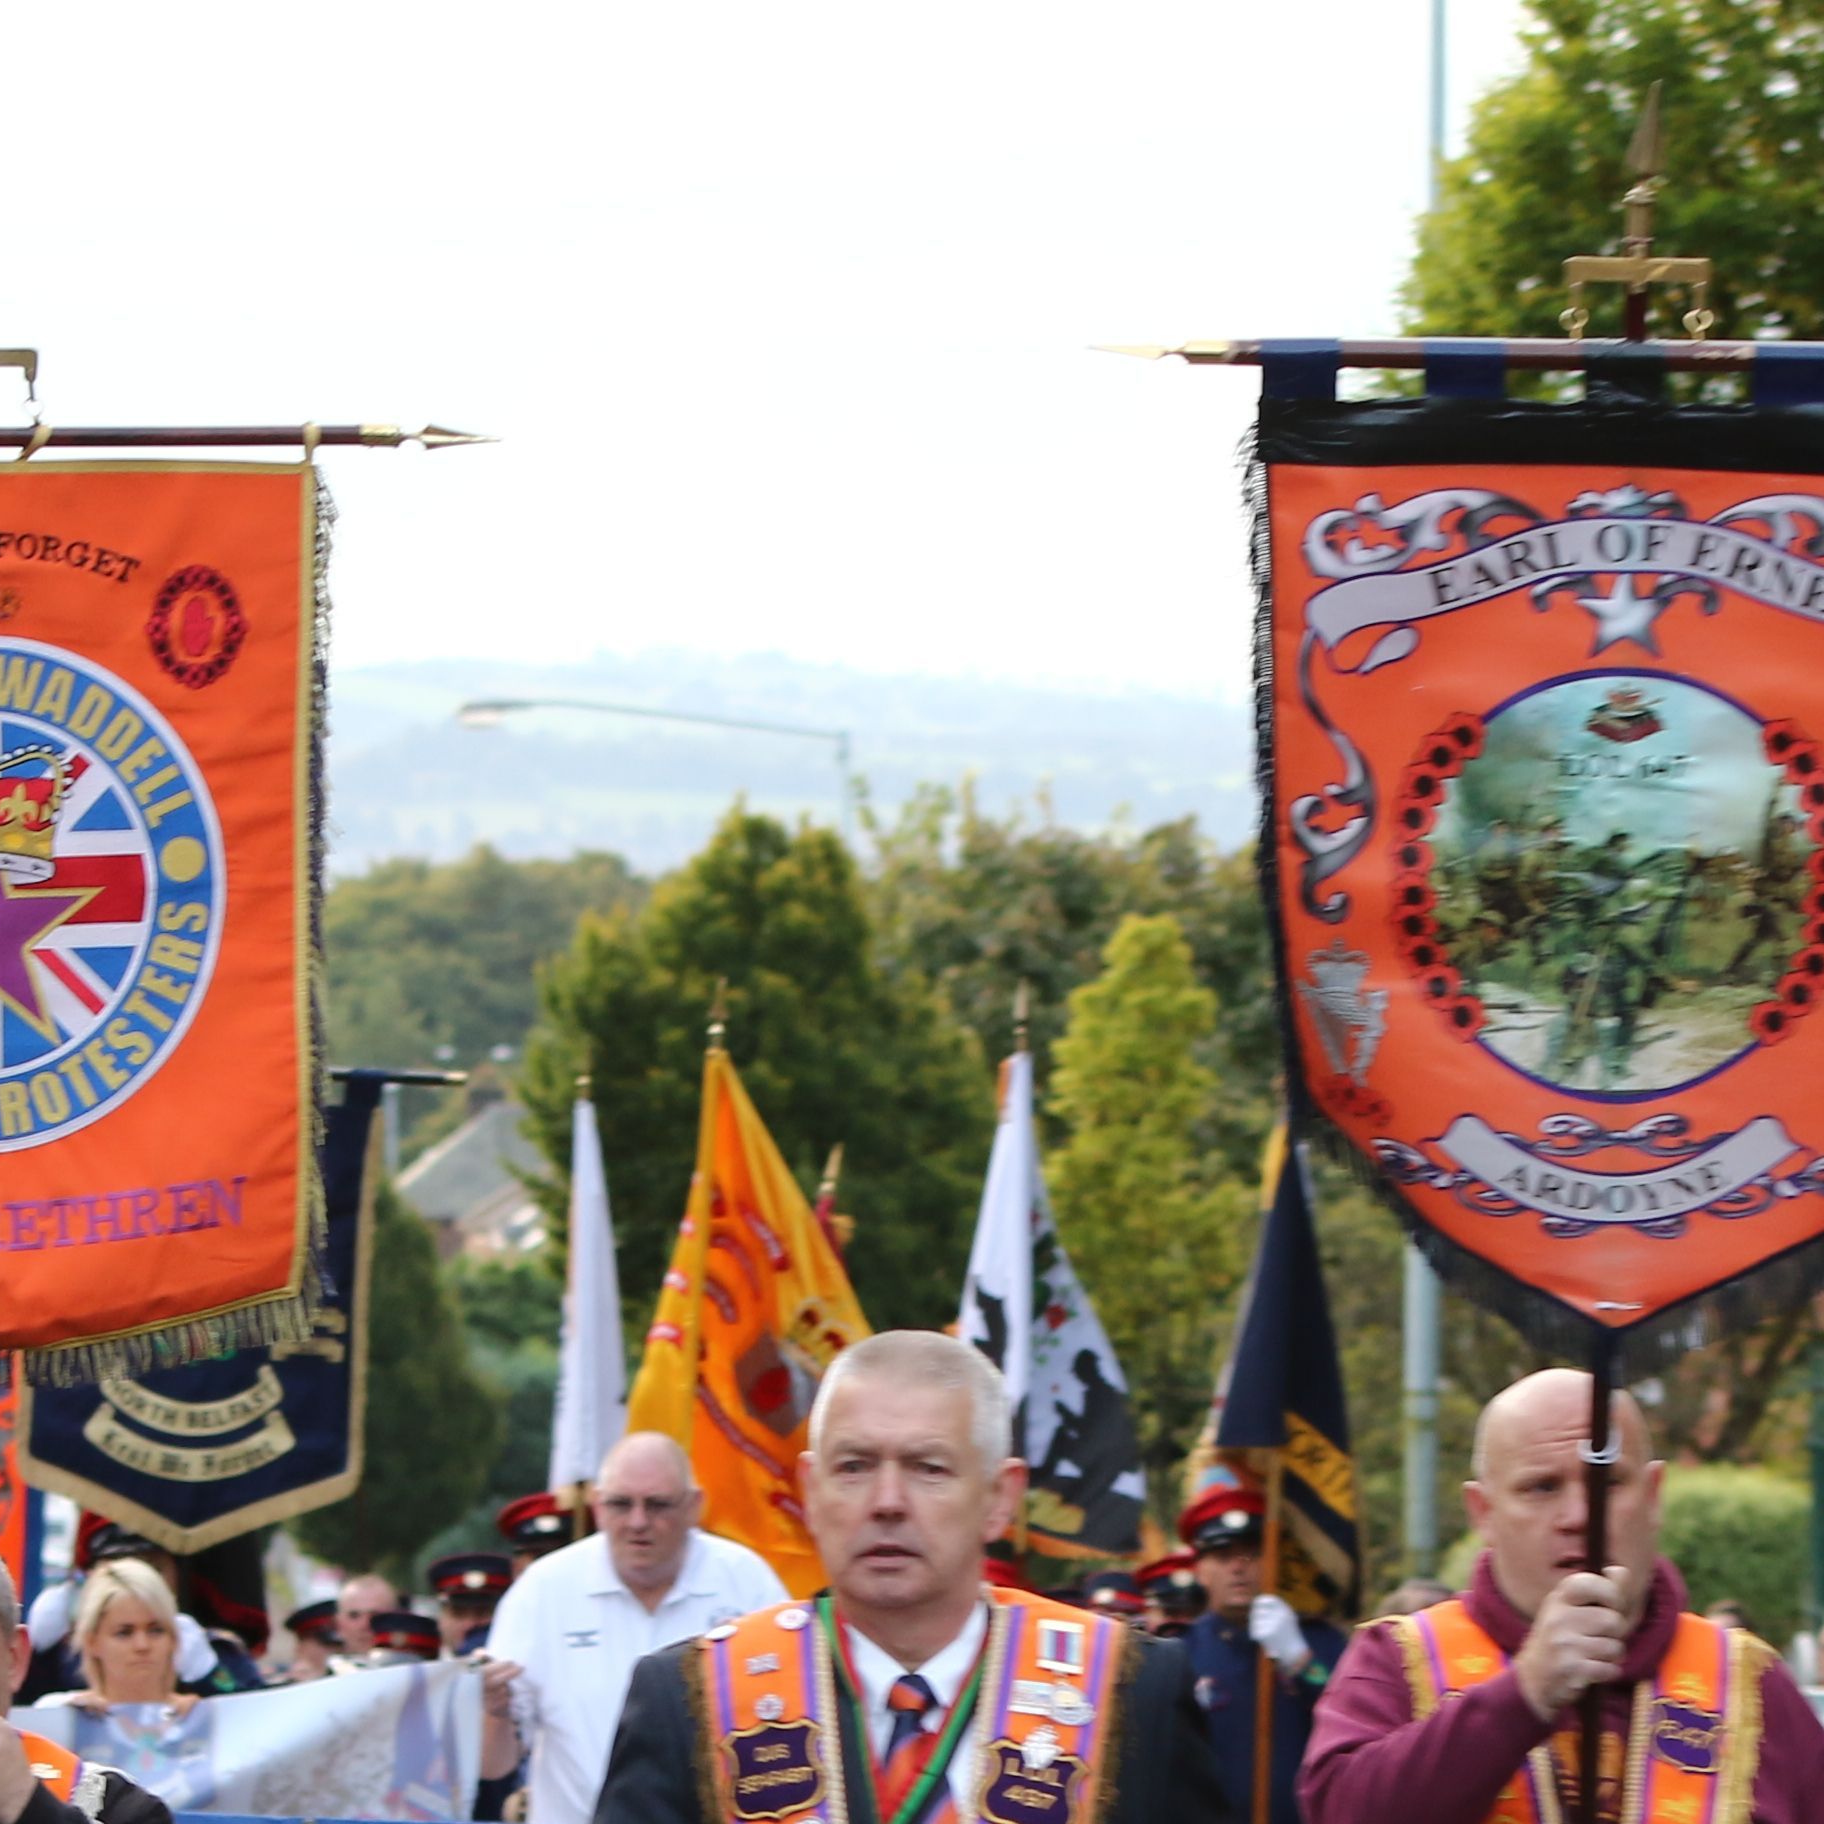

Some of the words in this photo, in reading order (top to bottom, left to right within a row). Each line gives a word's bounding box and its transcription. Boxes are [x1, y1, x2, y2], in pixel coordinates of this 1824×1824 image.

[1429, 532, 1578, 607] EARL
[1595, 524, 1675, 565] OF
[1499, 1160, 1727, 1212] ARDOYNE
[186, 1380, 277, 1427] BELFAST
